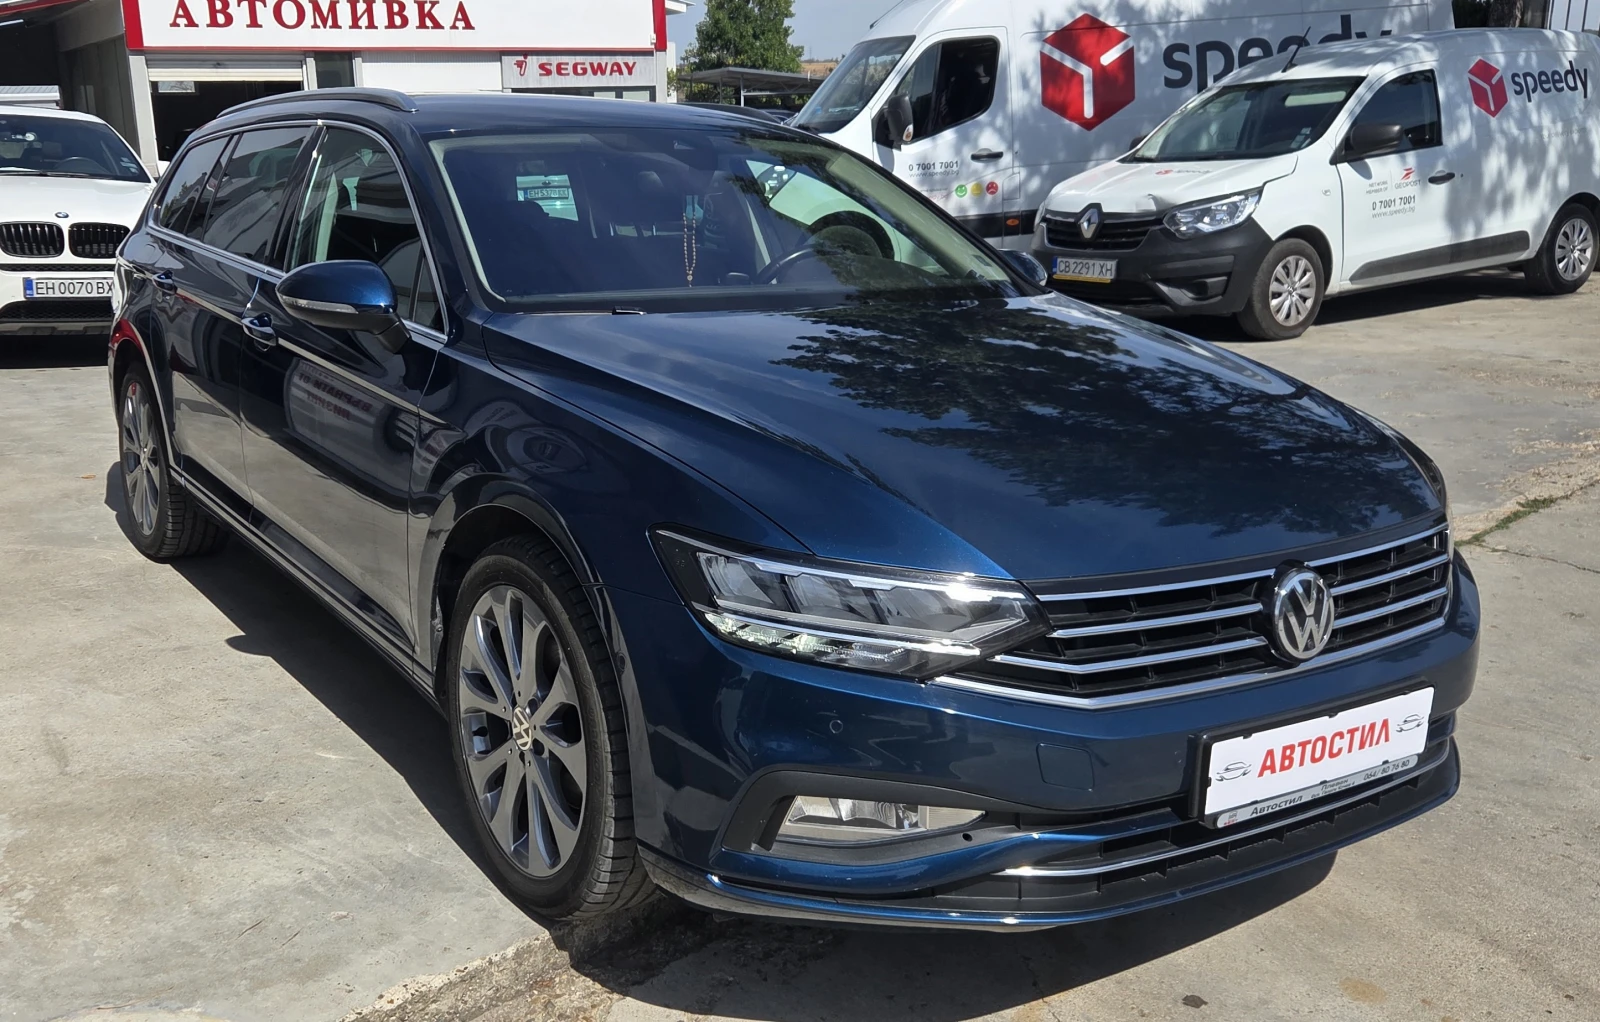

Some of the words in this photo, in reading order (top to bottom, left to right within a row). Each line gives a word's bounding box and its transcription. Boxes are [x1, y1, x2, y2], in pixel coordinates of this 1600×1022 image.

[169, 0, 476, 30] АВТОМИВКА
[537, 61, 637, 77] SEGWAY
[1510, 60, 1588, 103] speedy
[916, 162, 936, 171] 7001
[939, 160, 959, 169] 7001
[1371, 201, 1377, 211] 0
[1379, 198, 1396, 209] 7001
[1398, 194, 1416, 206] 7001
[1059, 260, 1071, 273] CB
[1072, 261, 1096, 276] 2291
[1098, 262, 1113, 277] XH
[35, 281, 56, 295] EH
[58, 281, 94, 295] 0070
[96, 281, 113, 295] BX
[1257, 718, 1391, 778] АВТОСТИЛ
[1250, 795, 1303, 817] Автостил
